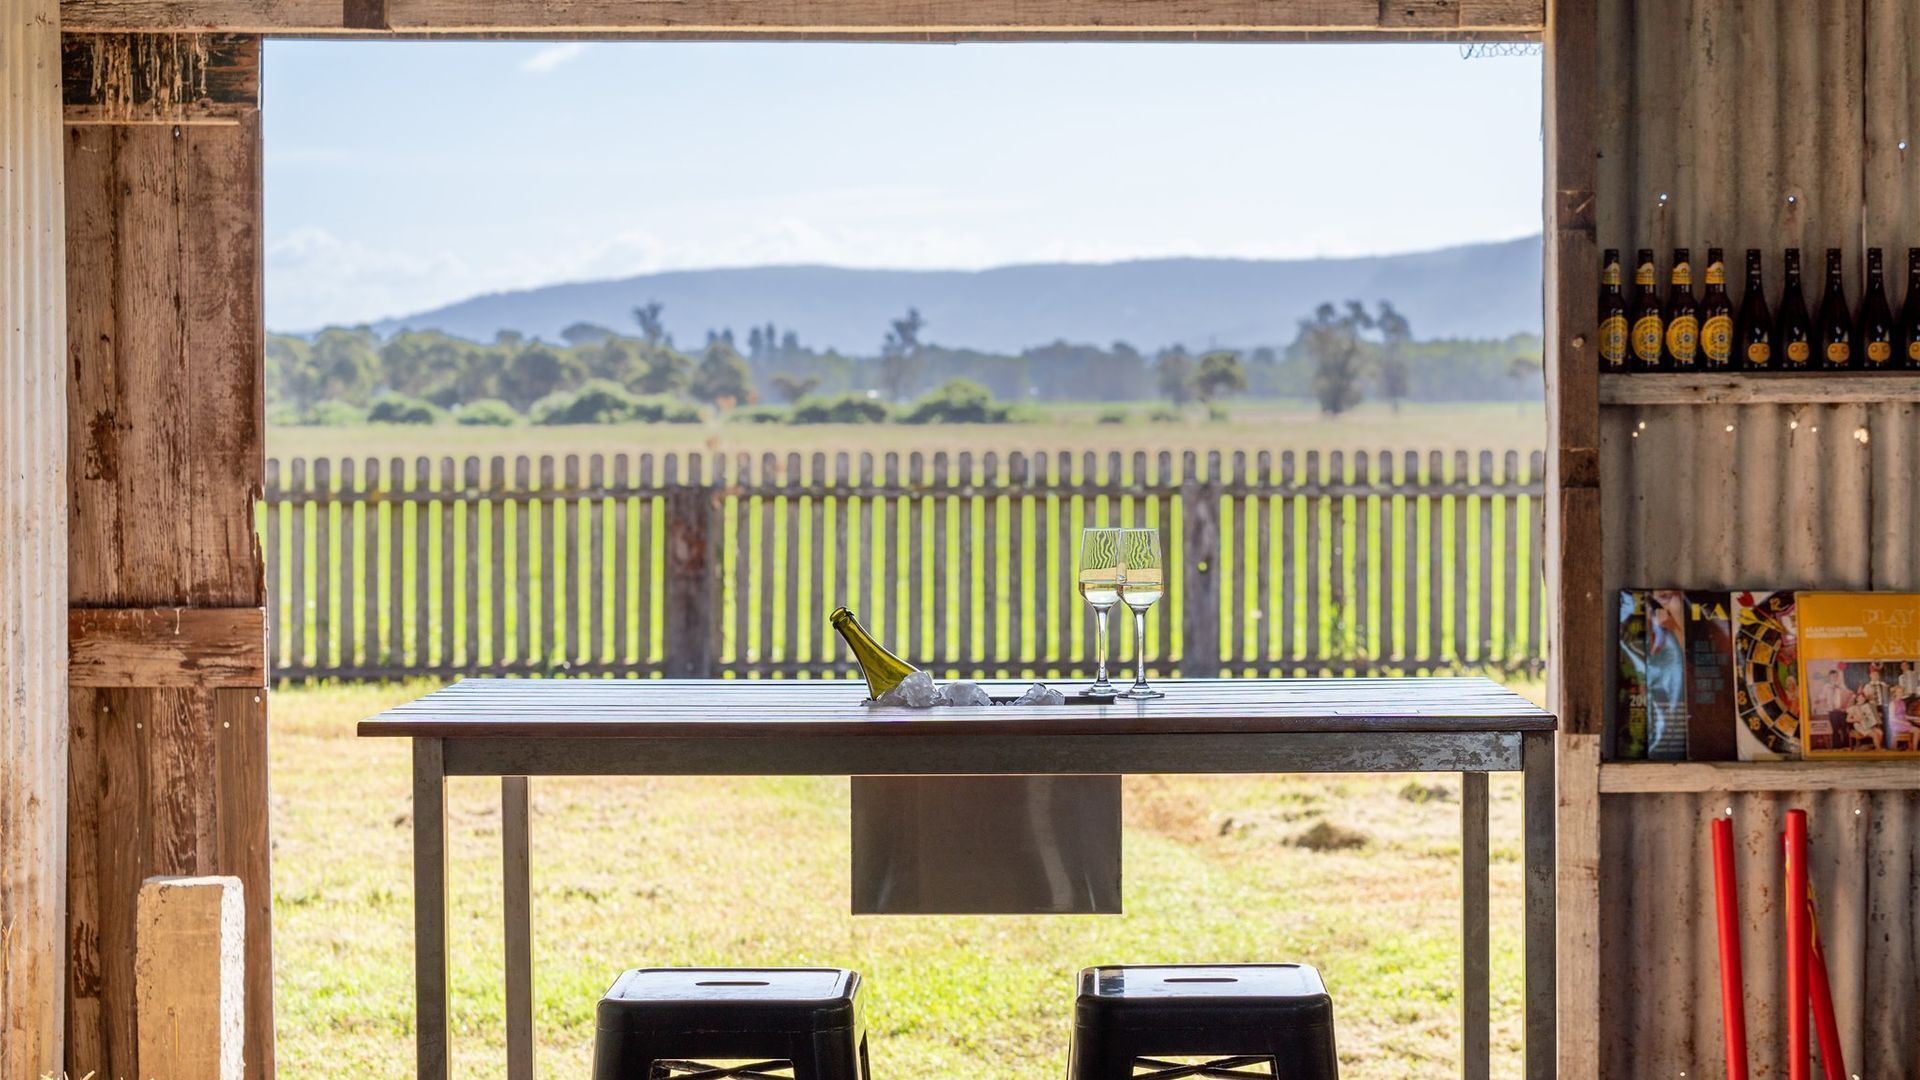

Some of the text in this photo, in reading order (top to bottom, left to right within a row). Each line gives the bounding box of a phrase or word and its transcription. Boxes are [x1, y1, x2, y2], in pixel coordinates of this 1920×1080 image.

[1769, 598, 1780, 611] 12
[1861, 608, 1915, 624] PLAY
[1884, 624, 1907, 640] IT
